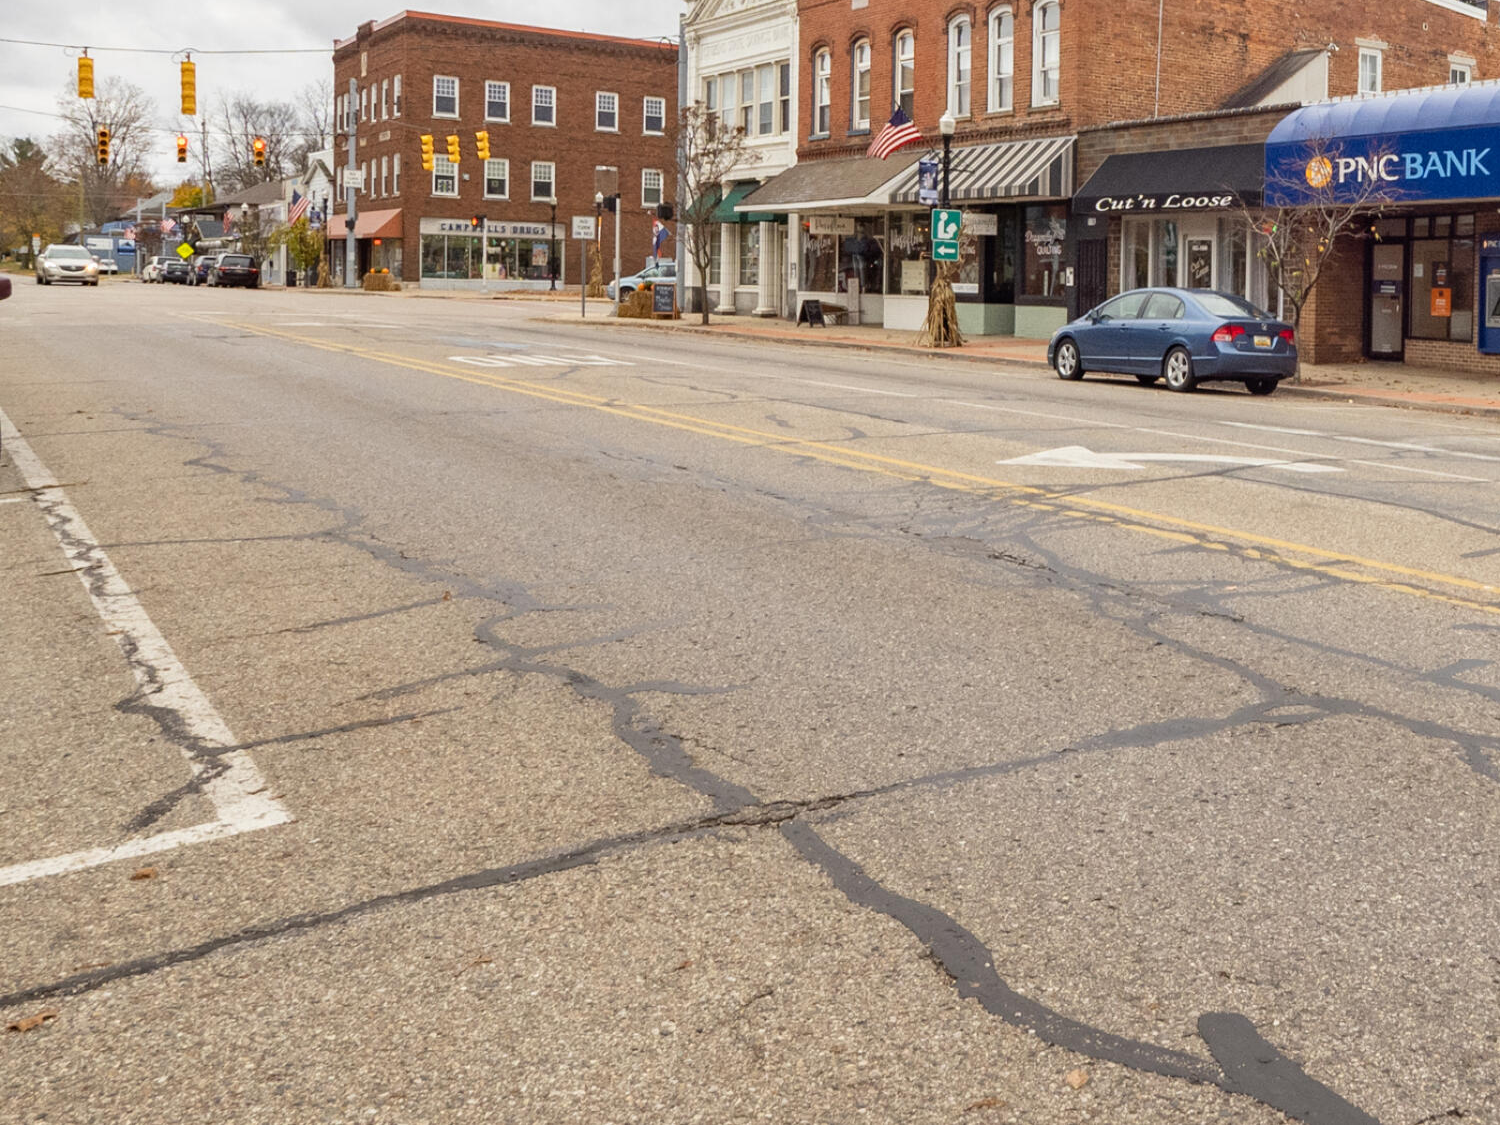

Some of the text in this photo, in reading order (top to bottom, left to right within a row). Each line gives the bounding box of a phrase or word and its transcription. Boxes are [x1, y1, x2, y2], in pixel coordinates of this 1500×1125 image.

[1336, 148, 1491, 183] PNC BANK
[1095, 194, 1232, 211] Cut'n Loose
[512, 226, 546, 234] DRUGS
